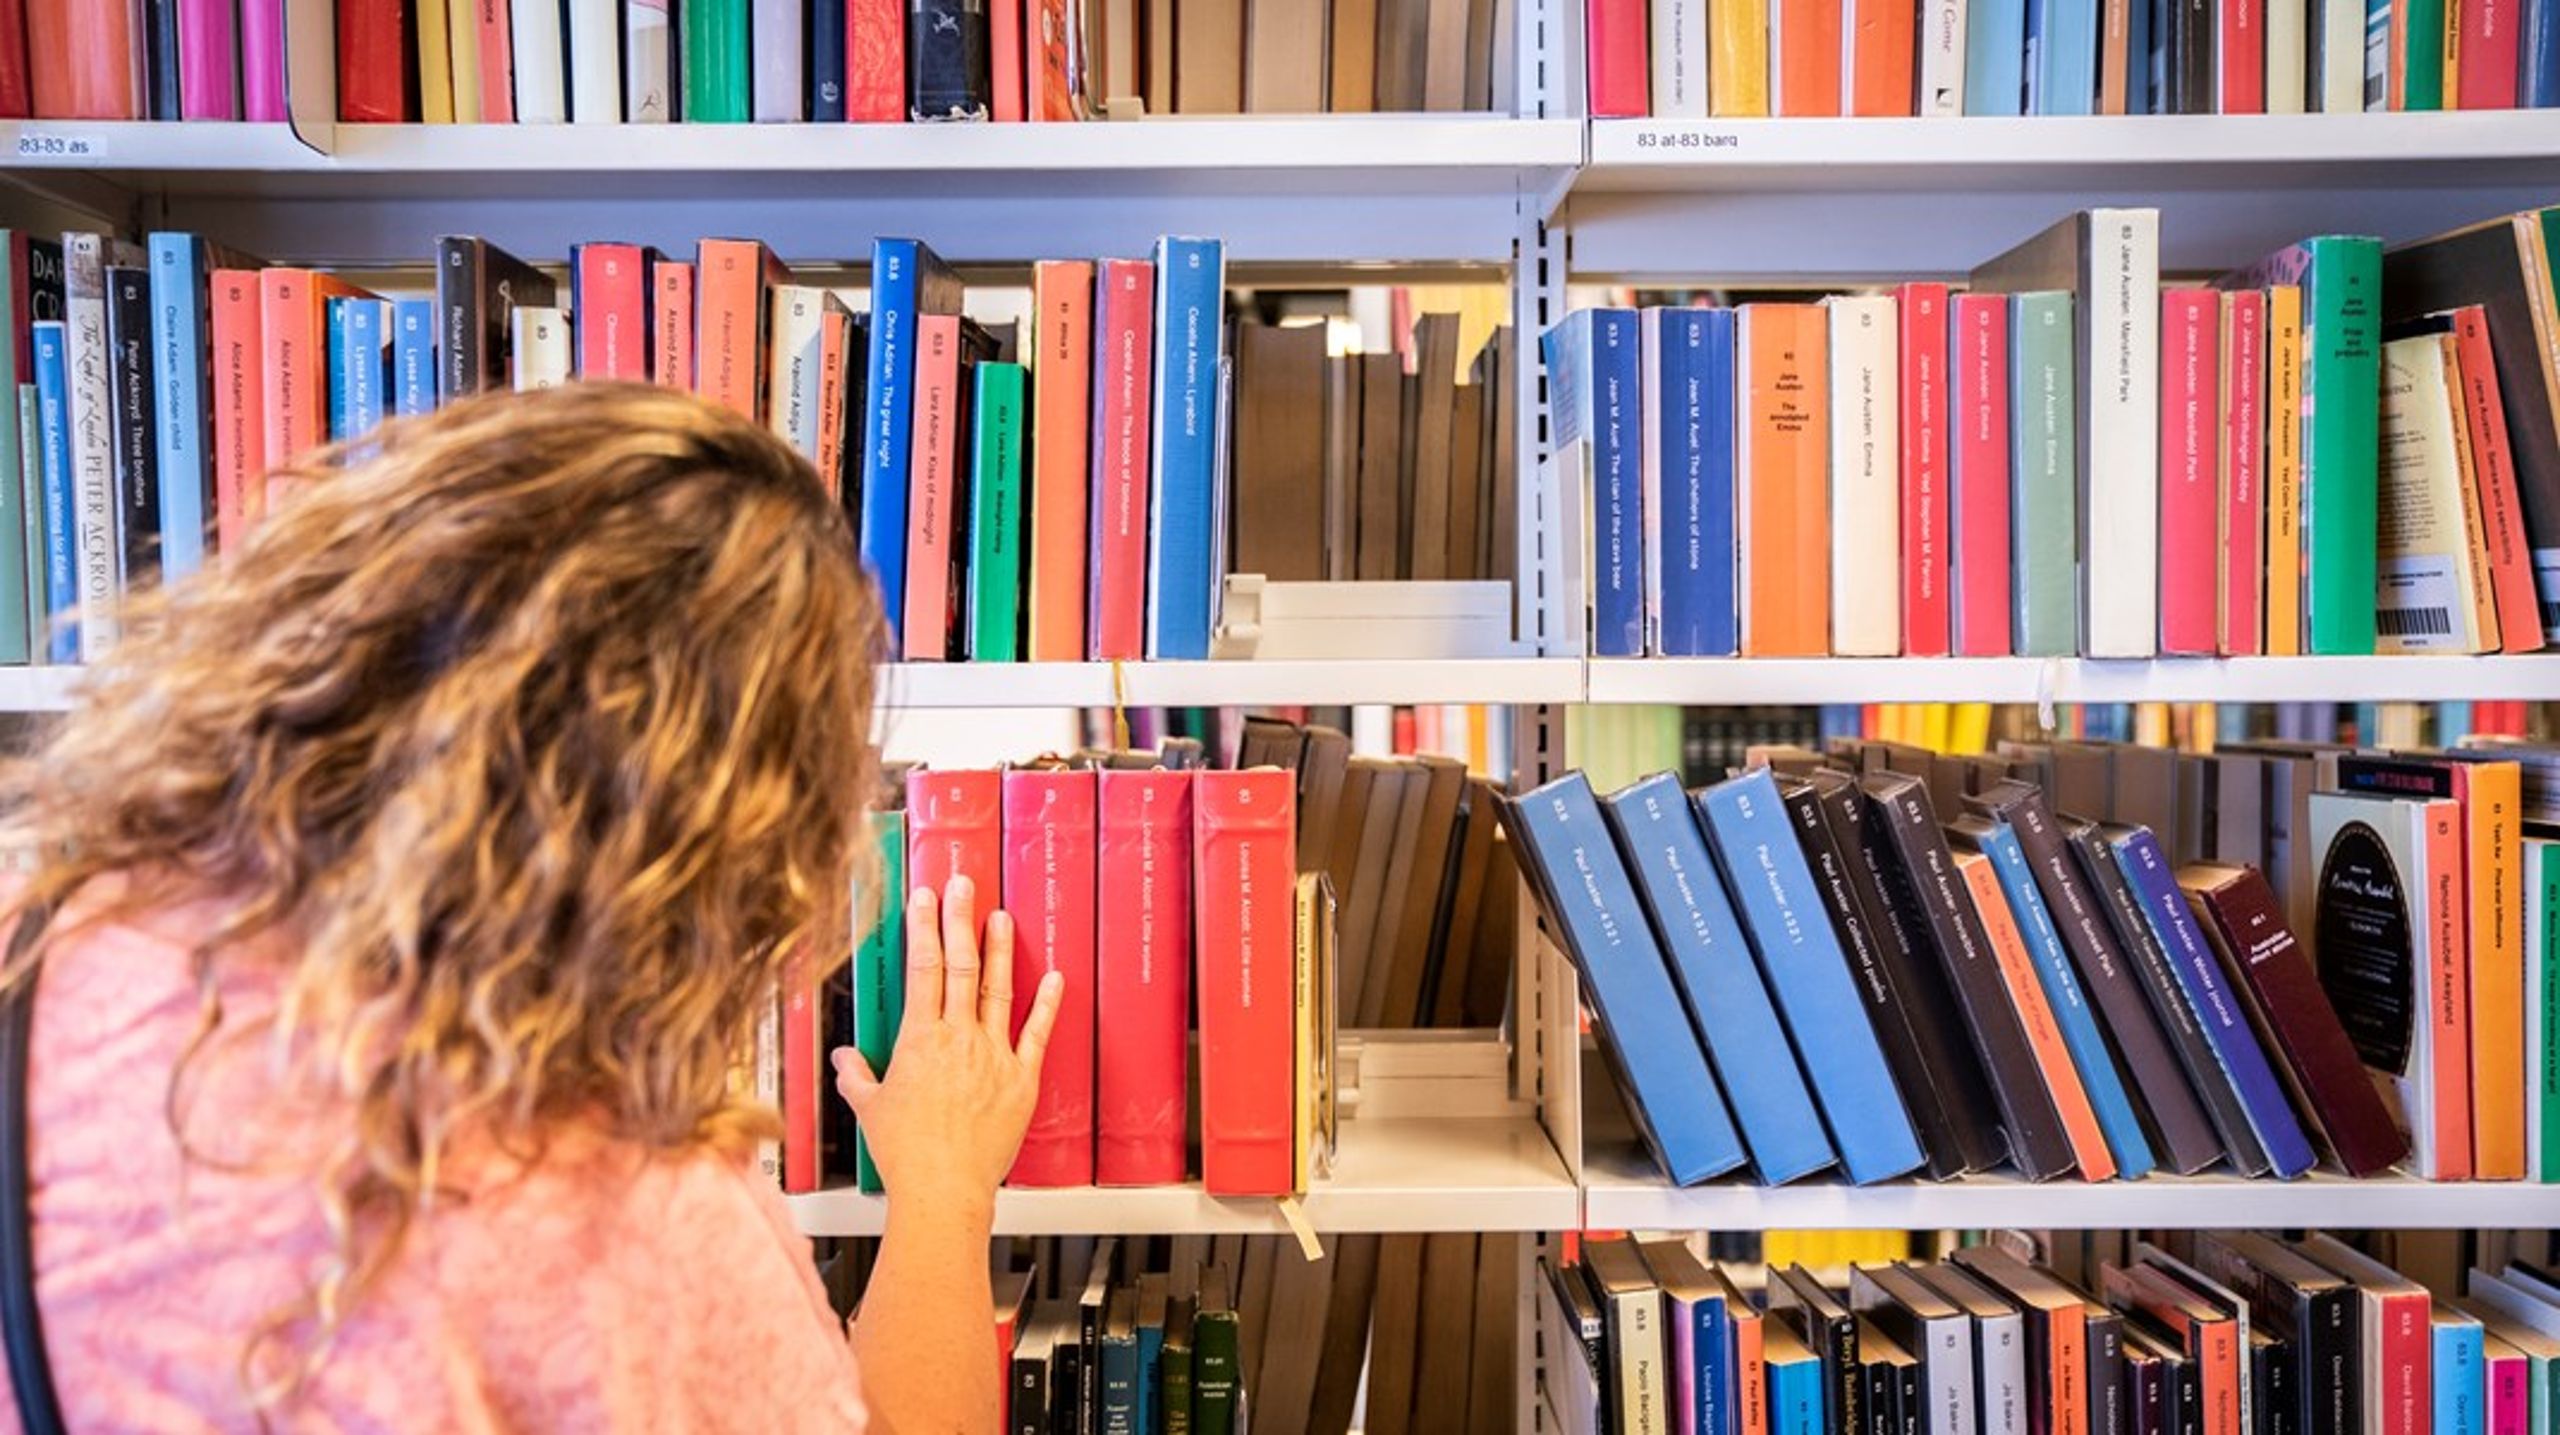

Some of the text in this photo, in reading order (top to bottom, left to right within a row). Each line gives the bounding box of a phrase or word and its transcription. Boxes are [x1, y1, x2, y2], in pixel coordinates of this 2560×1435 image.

[19, 138, 64, 153] 83-83
[1638, 134, 1656, 146] 83
[2122, 245, 2130, 272] Jane
[166, 306, 176, 338] Claire
[452, 306, 462, 350] Richard
[667, 309, 678, 351] Aravind
[723, 311, 732, 352] Aravind
[886, 310, 897, 339] Chris
[128, 340, 139, 368] Peter
[232, 342, 242, 368] Alice
[282, 340, 291, 367] Alice
[2120, 321, 2130, 375] Mansfield
[2242, 328, 2251, 354] Jane
[355, 346, 366, 402] Lyssa Kay
[406, 349, 417, 380] Lyssa
[792, 356, 801, 398] Aravind
[1921, 354, 1930, 381] Jane
[1610, 378, 1618, 404] Jean
[1690, 378, 1699, 404] Jean
[1863, 368, 1872, 394] Jane
[1980, 330, 1990, 440] Jane Emma
[2120, 378, 2129, 402] Park
[170, 380, 180, 420] Golden
[407, 384, 418, 410] Kay
[882, 386, 893, 406] The
[930, 387, 940, 410] Lara
[2187, 326, 2197, 481] Jane Mansfield Park
[880, 409, 891, 436] great
[1122, 416, 1132, 435] The
[1185, 389, 1196, 435] Lyrebird
[2045, 365, 2056, 474] Jane Emma
[134, 427, 144, 456] Three
[171, 423, 181, 450] child
[1922, 428, 1931, 463] Emma
[2239, 402, 2249, 464] Northanger
[878, 440, 890, 467] night
[1122, 437, 1132, 465] book
[1612, 454, 1620, 474] The
[1690, 455, 1700, 474] The
[1864, 442, 1873, 476] Emma
[928, 456, 936, 480] Kiss
[1122, 468, 1130, 480] of
[2485, 450, 2502, 484] Sense
[86, 456, 104, 514] PETER
[134, 459, 145, 507] brothers
[926, 484, 936, 494] of
[1612, 478, 1620, 500] clan
[2238, 467, 2248, 502] Abbey
[1120, 483, 1130, 535] tomorrow
[1612, 503, 1621, 515] of
[1690, 478, 1699, 521] shelters
[1612, 517, 1620, 534] the
[1690, 524, 1699, 536] of
[1612, 538, 1620, 563] cave
[1690, 539, 1699, 569] stone
[1612, 566, 1621, 589] bear
[1045, 823, 1055, 859] Louisa
[1142, 822, 1152, 860] Louisa
[1240, 842, 1250, 881] Louisa
[1572, 846, 1591, 872] Paul
[1664, 845, 1681, 869] Paul
[1755, 843, 1774, 870] Paul
[1819, 851, 1837, 878] Paul
[1844, 915, 1874, 967] Collected
[1925, 848, 1943, 874] Paul
[1951, 913, 1977, 960] Invisible
[2440, 874, 2450, 918] Ramona
[1046, 916, 1055, 943] Little
[1142, 914, 1152, 943] Little
[2048, 855, 2068, 882] Paul
[2079, 916, 2105, 955] Sunset
[2097, 952, 2116, 979] Park
[1142, 944, 1150, 983] women
[1242, 937, 1252, 965] Little
[2162, 892, 2181, 919] Paul
[2191, 954, 2215, 990] Winter
[2206, 988, 2233, 1028] journal
[1242, 968, 1250, 1007] women
[2443, 973, 2453, 1024] Awayland
[1842, 1335, 1854, 1368] Beryl
[1639, 1361, 1648, 1390] Paolo
[1704, 1365, 1712, 1400] Louise
[2334, 1356, 2343, 1386] David
[2403, 1365, 2412, 1396] David
[1949, 1387, 1956, 1399] Jo
[2003, 1384, 2012, 1397] Jo
[1950, 1402, 1958, 1433] Baker
[2004, 1400, 2013, 1431] Baker
[2456, 1394, 2468, 1425] David
